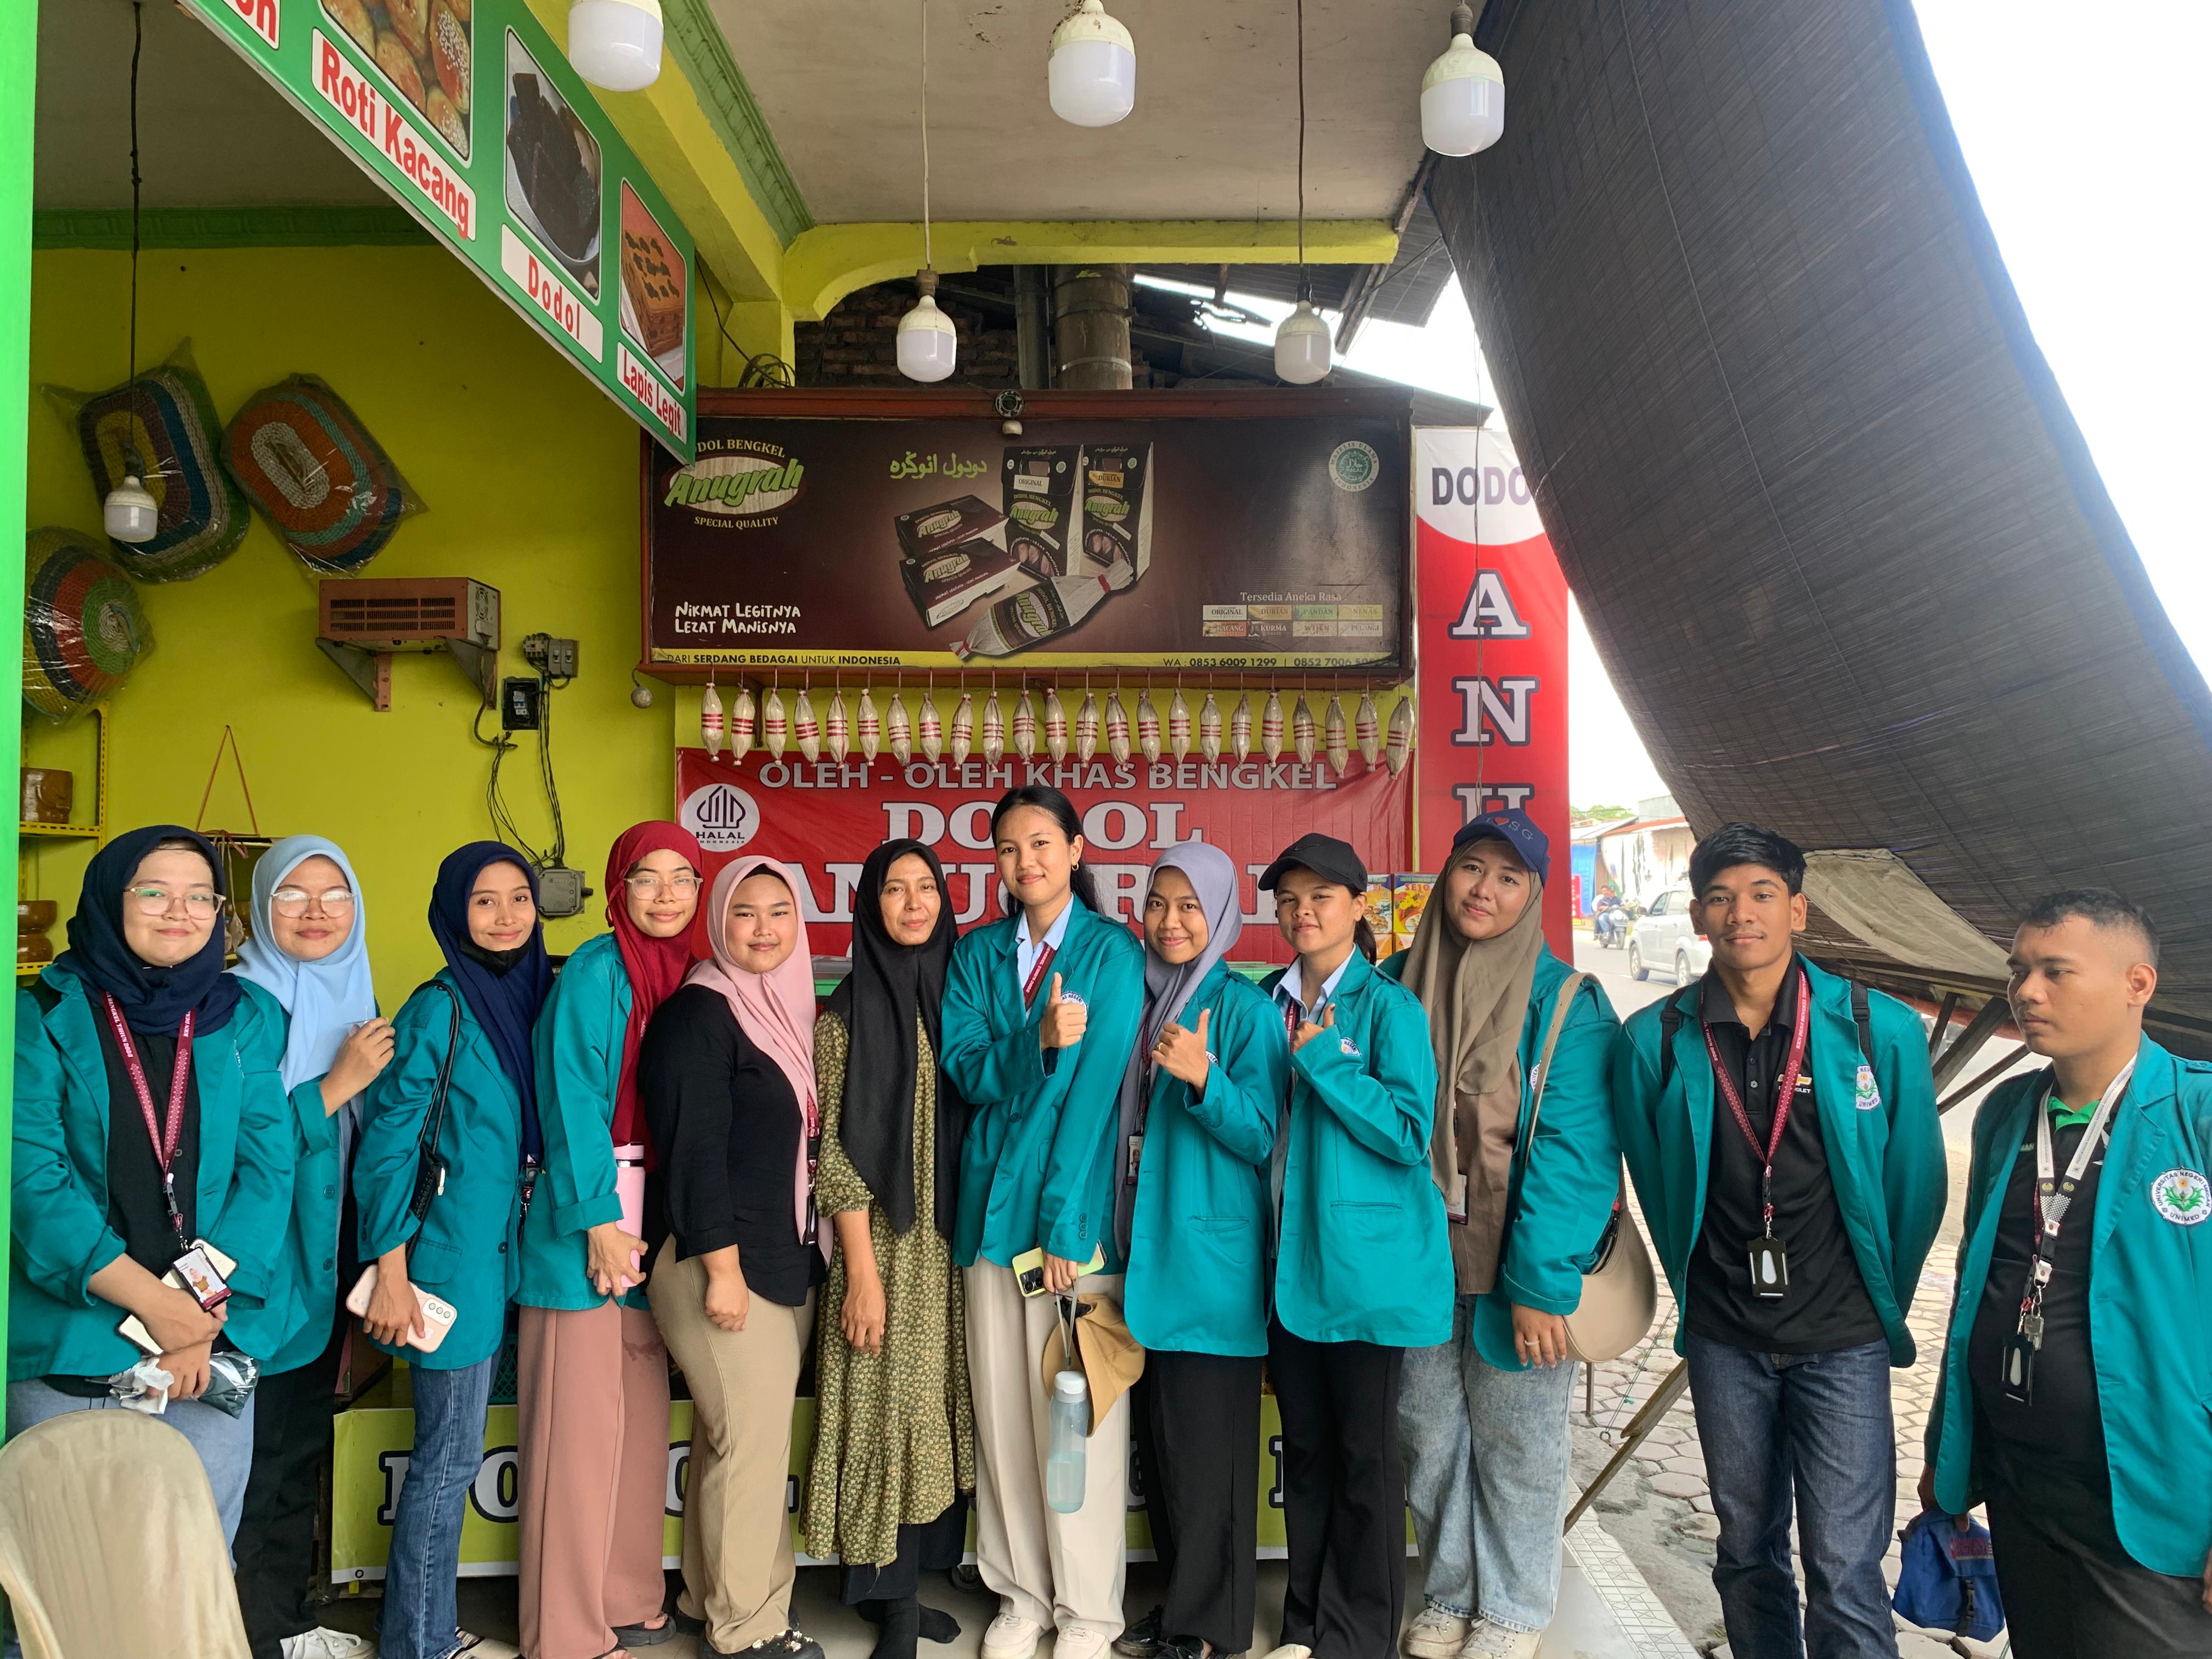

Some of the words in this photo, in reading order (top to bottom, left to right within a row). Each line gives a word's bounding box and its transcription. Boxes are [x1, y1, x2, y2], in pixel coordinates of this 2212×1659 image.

[321, 41, 376, 138] Roti
[386, 116, 469, 239] Kacang
[528, 255, 582, 340] Dodol
[624, 349, 653, 406] Lapis
[657, 379, 682, 436] Legit
[696, 439, 724, 453] DOL
[727, 439, 785, 458] BENGKEL
[664, 458, 804, 507] Anugrah
[1018, 478, 1042, 487] ORIGINAL
[1009, 506, 1059, 524] Anugrah
[1085, 499, 1131, 517] Anugrah
[694, 516, 734, 528] SPECIAL
[736, 517, 779, 530] QUALITY
[917, 510, 961, 538] Anugrah
[924, 553, 969, 583] Anugrah
[1240, 592, 1283, 601] Tersedia
[1285, 592, 1316, 601] Aneka
[1015, 592, 1053, 637] Anugrah
[675, 619, 716, 634] LEZAT
[668, 654, 690, 663] DARI
[693, 655, 747, 664] SERDANG
[750, 655, 798, 664] BEDAGAI
[802, 656, 836, 664] UNTUK
[838, 656, 901, 665] INDONESIA
[1189, 658, 1217, 667] 0853
[1220, 658, 1246, 667] 6009
[1250, 658, 1277, 667] 1299
[759, 761, 868, 789] OLEH
[905, 761, 1013, 789] OLEH
[1026, 763, 1141, 790] KHAS
[1147, 763, 1338, 791] BENGKEL
[882, 800, 1203, 850] DOOL
[108, 998, 120, 1023] BENGKEL
[116, 1023, 127, 1042] TAHUN
[1859, 1097, 1878, 1108] UNIMED
[2155, 1172, 2177, 1206] UNIVERSITAS
[2180, 1171, 2204, 1184] NEGERI
[2170, 1212, 2199, 1221] UNIMED
